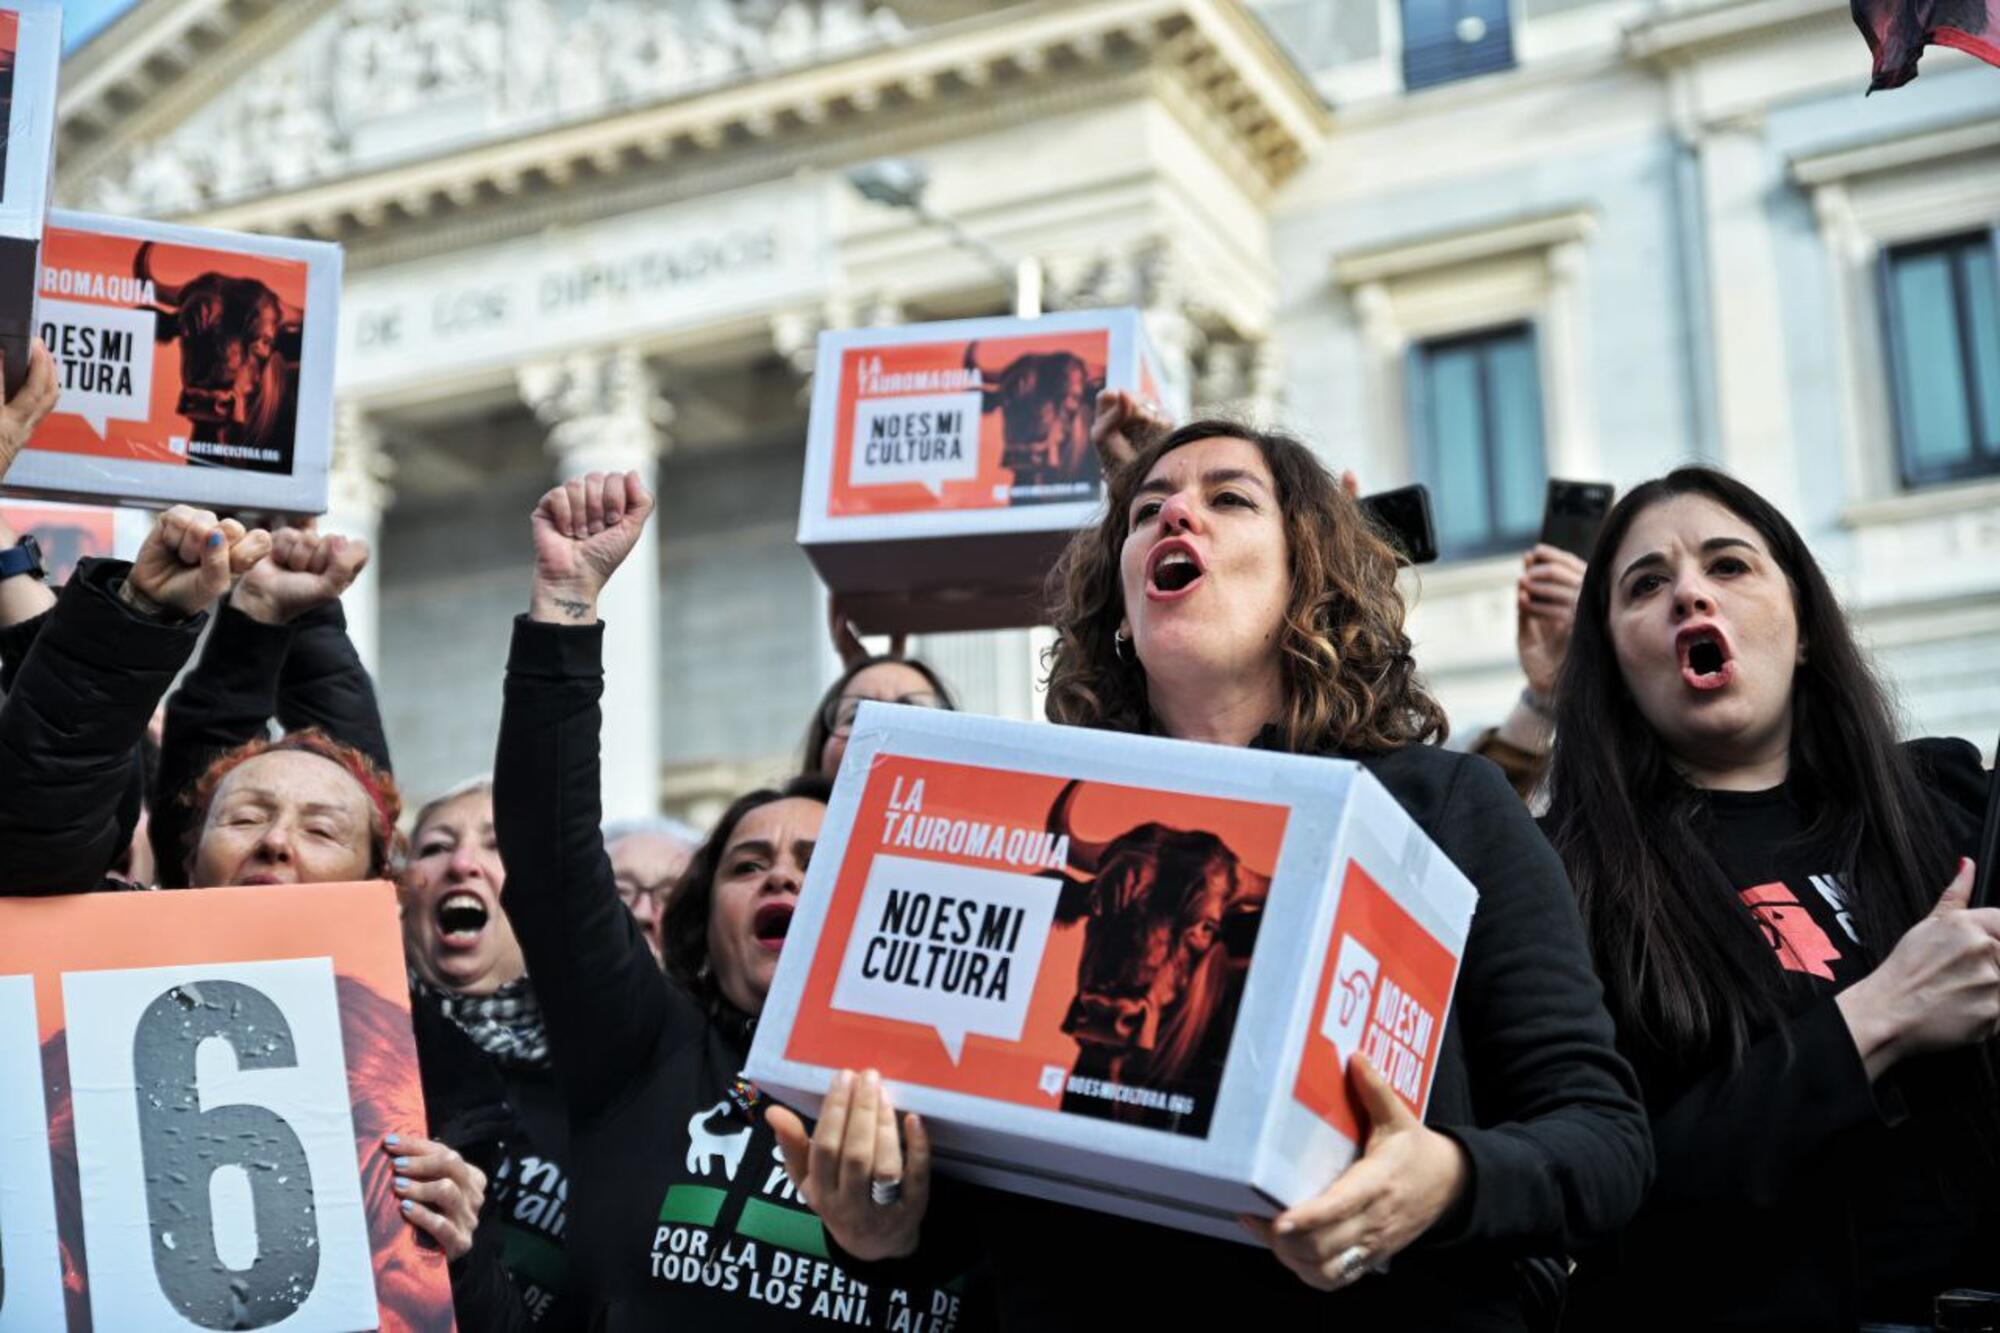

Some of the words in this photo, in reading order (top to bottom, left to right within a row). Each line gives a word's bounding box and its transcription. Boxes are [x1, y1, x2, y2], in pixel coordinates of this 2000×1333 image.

[41, 266, 156, 304] ROMAQUIA
[57, 359, 133, 396] TURA
[865, 439, 962, 466] CULTURA
[888, 776, 925, 813] LA
[882, 812, 1070, 869] TAUROMAQUIA
[861, 937, 1011, 1001] CULTURA
[133, 980, 320, 1332] 6
[650, 1251, 741, 1291] TODOS
[749, 1272, 802, 1310] LOS
[652, 1226, 709, 1257] POR
[720, 1240, 758, 1270] LA
[771, 1251, 907, 1304] DEFENA
[931, 1289, 960, 1321] DE
